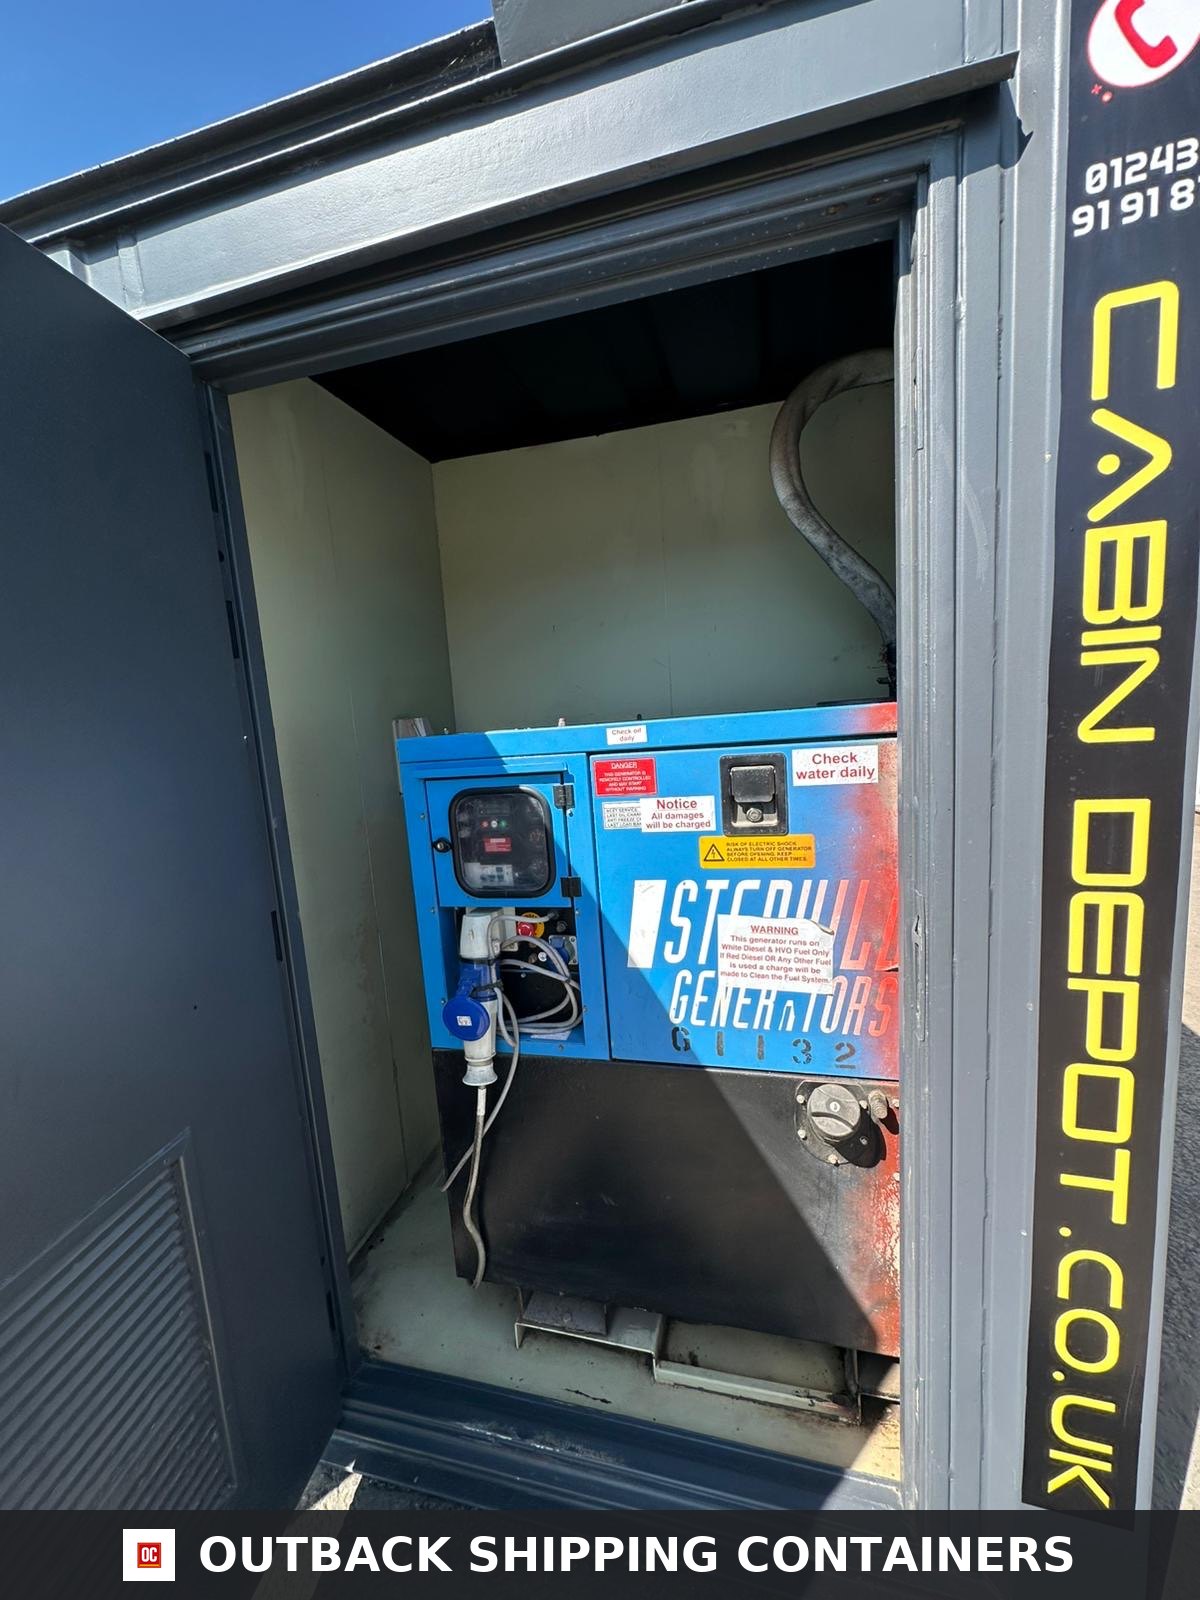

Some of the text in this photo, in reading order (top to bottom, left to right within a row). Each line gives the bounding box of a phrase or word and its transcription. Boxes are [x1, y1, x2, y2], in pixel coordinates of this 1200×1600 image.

[1085, 137, 1199, 194] 01243
[1072, 176, 1200, 237] 91 91 8
[1077, 280, 1180, 743] CABIN
[611, 728, 632, 736] Check
[812, 752, 858, 765] Check
[611, 761, 637, 769] DANGER
[796, 766, 875, 779] water daily
[656, 799, 698, 810] Notice
[665, 811, 704, 820] damages
[645, 820, 711, 829] will be charged
[750, 925, 799, 935] WARNING
[749, 936, 787, 945] generator
[812, 949, 830, 957] Only
[777, 956, 791, 964] Any
[815, 958, 831, 966] Fuel
[738, 962, 757, 970] used
[766, 964, 793, 974] charge
[784, 974, 800, 982] Fuel
[801, 975, 831, 984] System.
